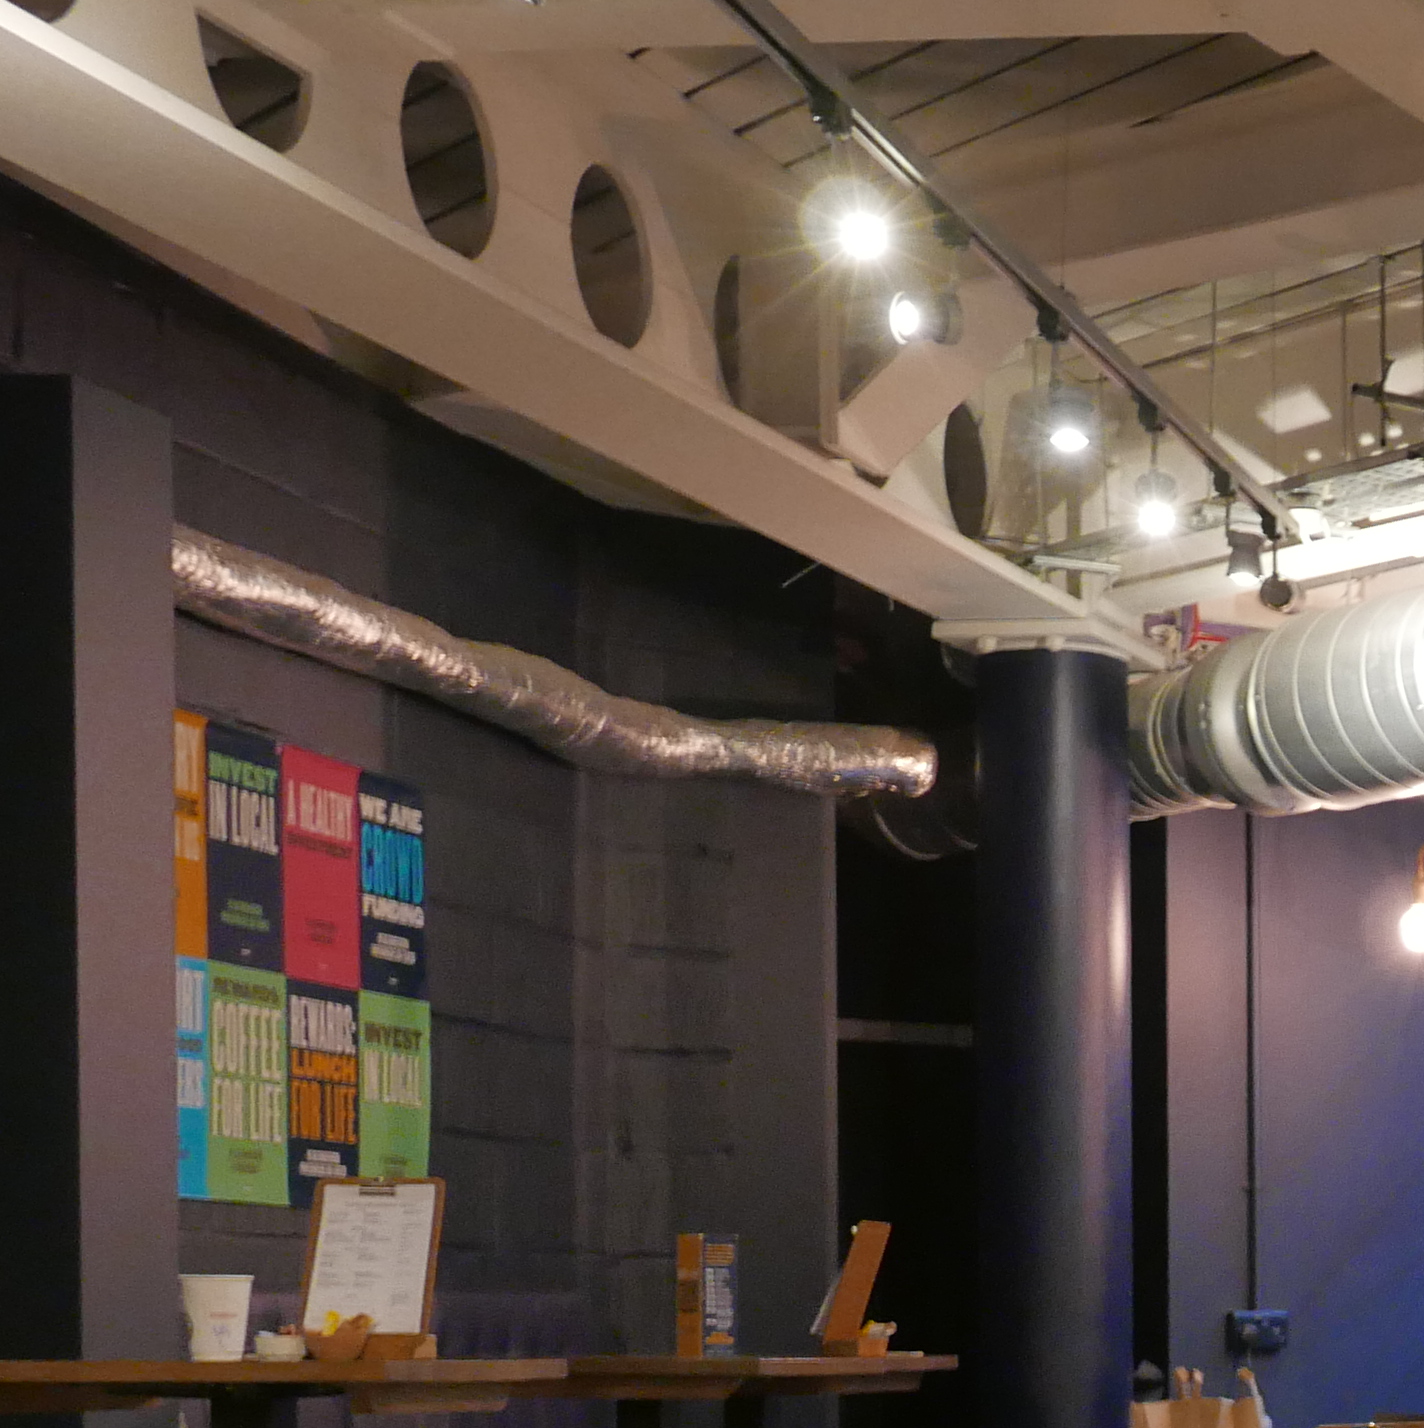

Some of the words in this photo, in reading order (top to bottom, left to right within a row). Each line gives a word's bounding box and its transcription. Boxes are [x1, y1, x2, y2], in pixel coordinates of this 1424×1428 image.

[208, 780, 228, 841] IN
[231, 784, 279, 855] LOCAL
[286, 779, 296, 826] A
[299, 782, 353, 841] HEALTHY
[359, 793, 387, 824] WE
[389, 802, 423, 834] ARE
[361, 821, 424, 904] CROWD
[212, 999, 282, 1080] COFFEE
[290, 1049, 357, 1084] LUNCH
[364, 1023, 422, 1050] INVEST
[363, 1049, 380, 1101] IN
[382, 1051, 422, 1108] LOCAL
[212, 1078, 243, 1137] FOR
[249, 1083, 282, 1143] LIFE
[290, 1080, 321, 1141] FOR
[325, 1083, 357, 1144] LIFE
